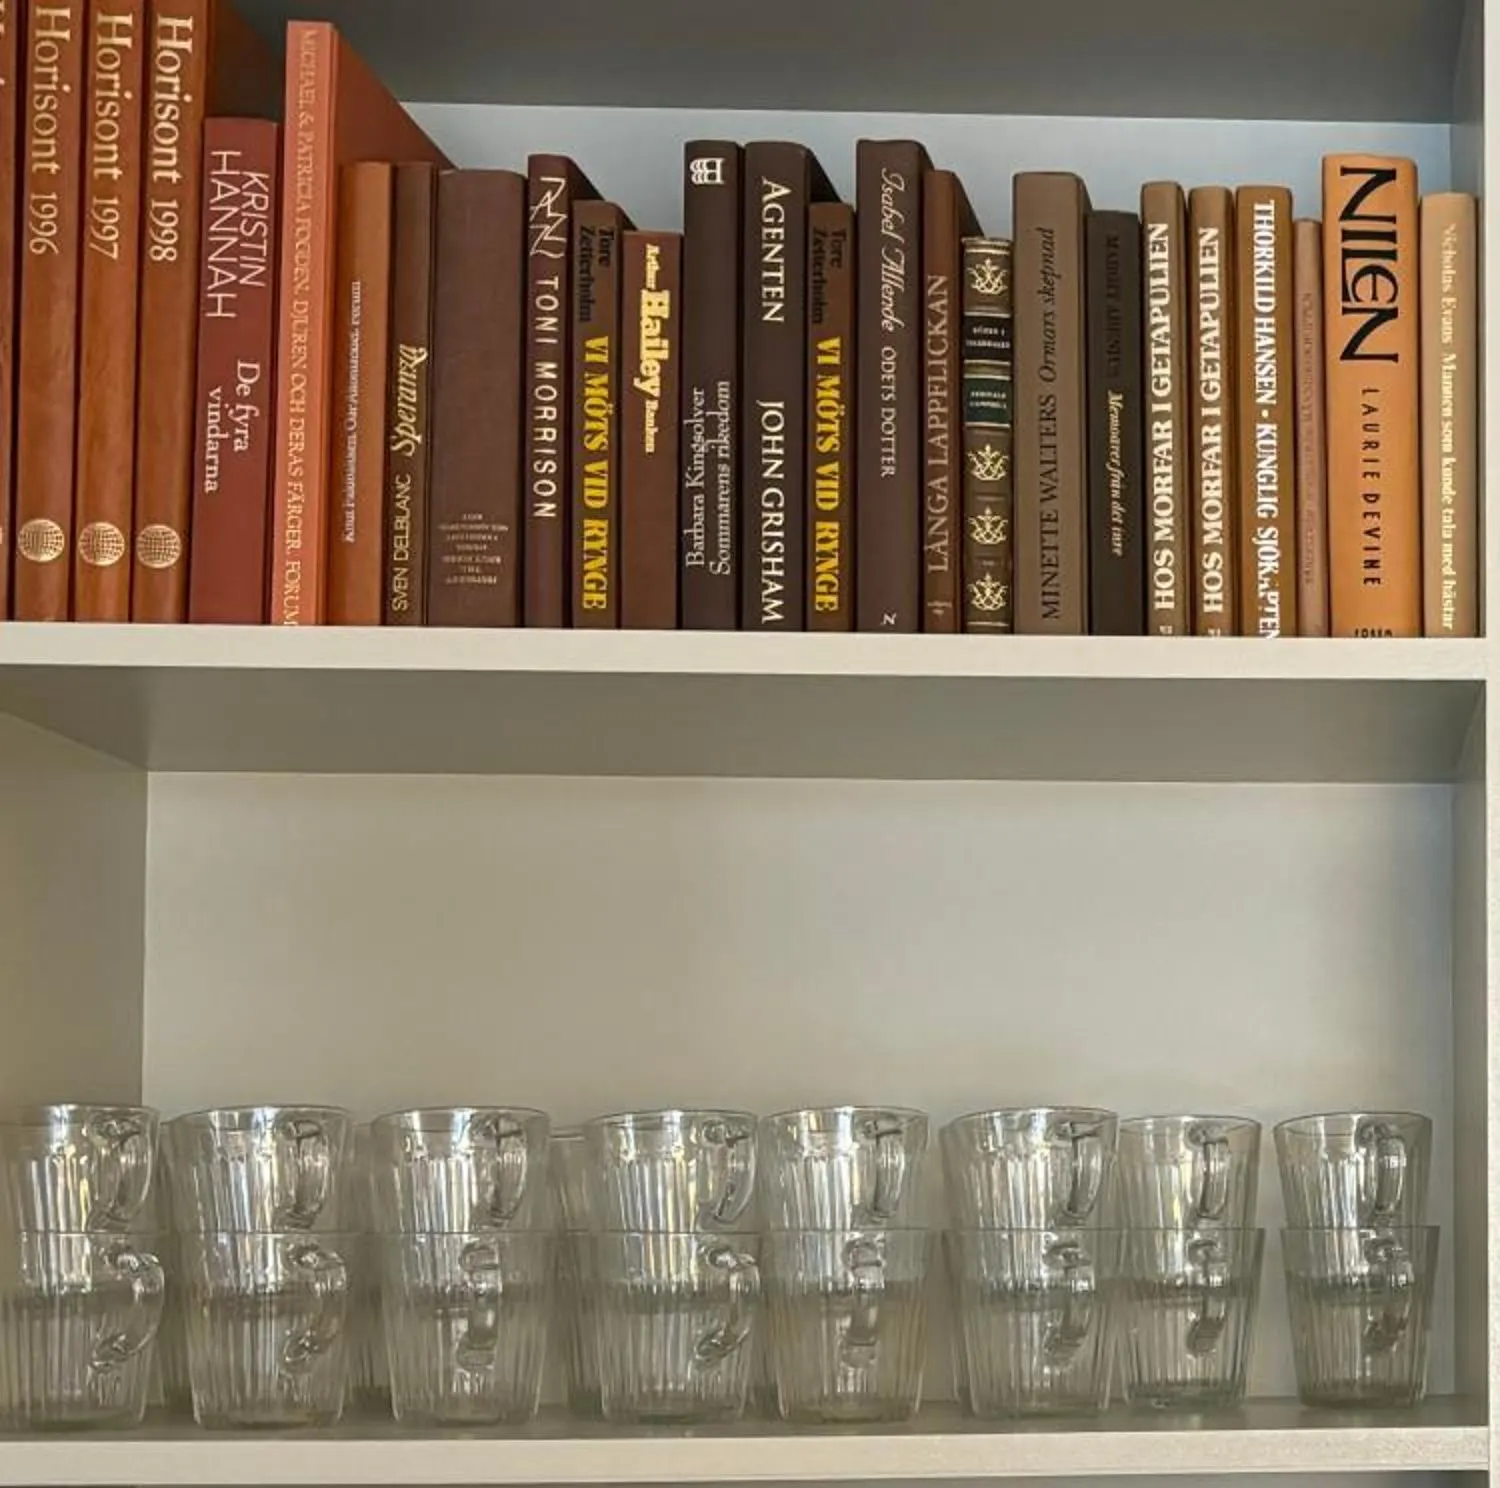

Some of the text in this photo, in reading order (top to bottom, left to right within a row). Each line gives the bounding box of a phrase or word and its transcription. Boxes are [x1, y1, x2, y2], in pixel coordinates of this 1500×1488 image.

[298, 30, 317, 109] MICHAEL
[28, 6, 72, 255] Horisont 1996
[89, 13, 133, 259] Horisont 1997
[149, 16, 194, 261] Horisont 1998
[298, 112, 315, 129] &
[295, 131, 315, 212] PATRICIA
[881, 168, 906, 244] Isabel
[205, 151, 241, 318] HANNAH
[239, 170, 269, 288] KRISTIN
[598, 227, 615, 267] Tore
[830, 228, 847, 268] Tore
[1253, 199, 1277, 312] THORKILD
[1441, 223, 1457, 293] Nicholas
[289, 301, 309, 369] DJUREN
[534, 276, 559, 343] TONI
[881, 247, 906, 331] Allende
[1148, 223, 1173, 397] GETAPULIEN
[1198, 227, 1221, 401] GETAPULIEN
[1441, 297, 1457, 344] Evans
[634, 289, 670, 398] Hailey
[926, 274, 949, 465] LAPPFLICKAN
[1254, 317, 1277, 405] HANSEN
[1339, 166, 1399, 587] NILEN LAURIE DEVINE
[232, 360, 260, 452] De fyra
[289, 373, 307, 413] OCH
[533, 361, 558, 517] MORRISON
[756, 176, 792, 624] AGENTEN JOHN GRISHAM
[1034, 226, 1062, 619] MINETTE WALTERS Ormars skepnad
[1151, 402, 1173, 412] I
[1200, 407, 1221, 417] I
[1441, 420, 1454, 452] som
[203, 387, 229, 493] vindarna
[287, 418, 305, 477] DERAS
[390, 344, 427, 611] SVEN DELBLANC Speranza
[582, 336, 615, 609] VI MÖTS VID RYNGE
[683, 387, 708, 566] Barbara Kingsolver
[706, 380, 731, 575] Sommarens rikedom
[814, 336, 845, 611] VI MÖTS VID RYNGE
[880, 407, 896, 478] DOTTER
[1152, 420, 1174, 541] MORFAR
[1201, 424, 1223, 545] MORFAR
[1255, 423, 1278, 518] KUNGLIG
[1441, 457, 1457, 505] kunde
[924, 474, 949, 573] LÅNGA
[1441, 508, 1457, 538] tala
[1441, 543, 1457, 576] med
[283, 560, 302, 625] FORUM
[1153, 549, 1175, 610] HOS
[1202, 552, 1223, 613] HOS
